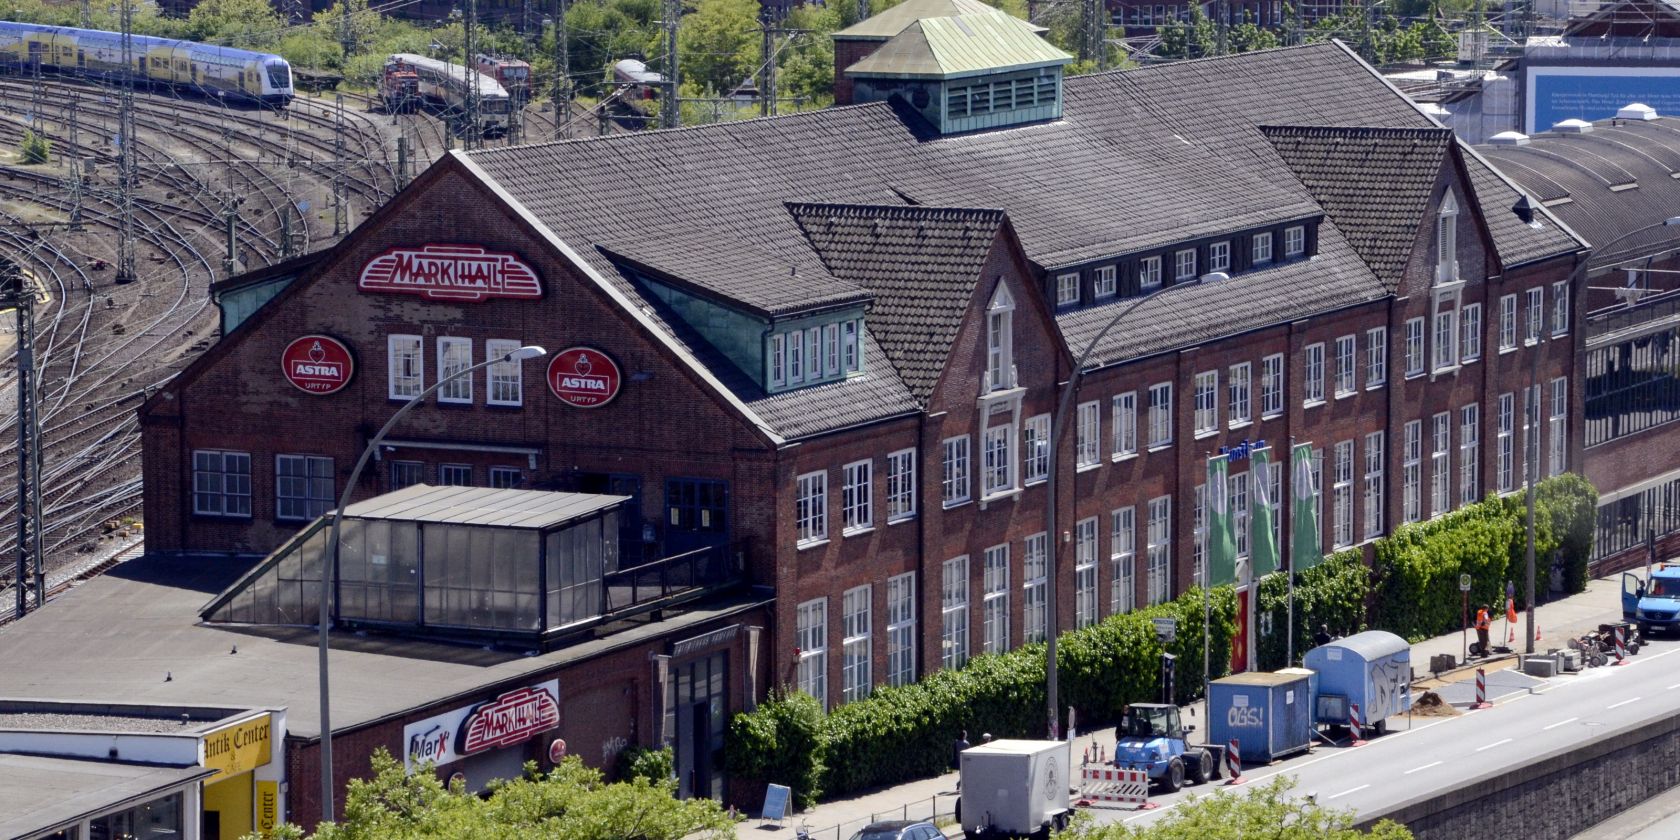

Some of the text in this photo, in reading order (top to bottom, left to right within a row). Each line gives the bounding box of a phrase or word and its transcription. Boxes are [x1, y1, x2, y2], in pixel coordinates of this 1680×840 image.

[296, 364, 339, 377] ASTRA
[305, 382, 331, 390] URTYP
[561, 377, 605, 390] ASTRA
[570, 395, 597, 403] URTYP
[233, 723, 270, 749] Center
[261, 791, 274, 830] Center
